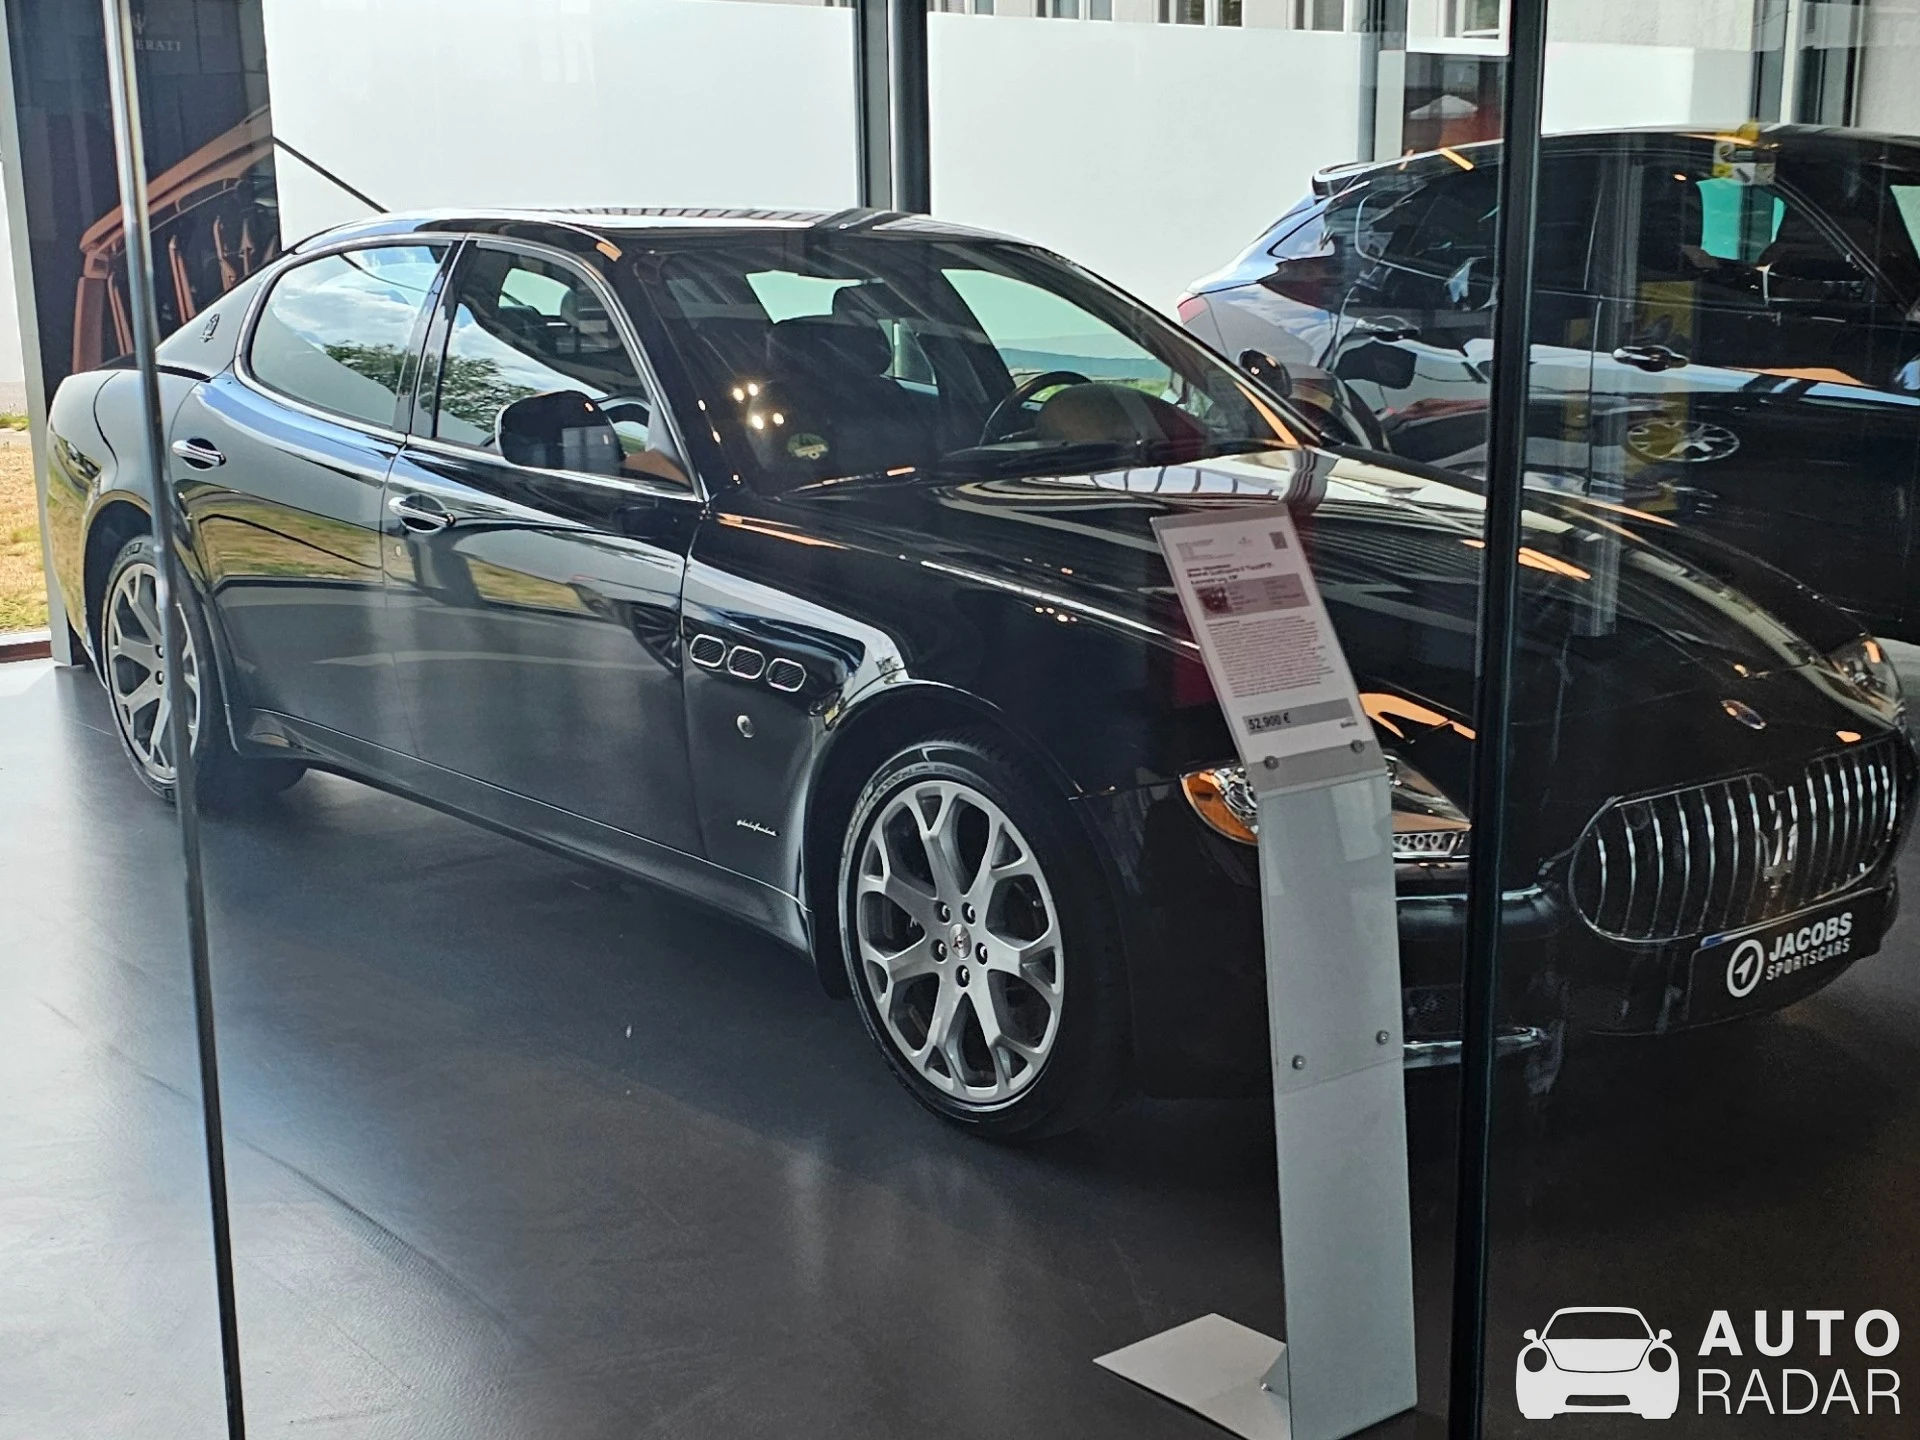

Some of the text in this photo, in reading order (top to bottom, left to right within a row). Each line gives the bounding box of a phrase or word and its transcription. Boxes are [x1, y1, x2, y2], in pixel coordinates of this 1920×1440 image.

[1283, 711, 1291, 724] €
[1765, 937, 1851, 981] SPORTSCARS
[1768, 912, 1853, 962] JACOBS
